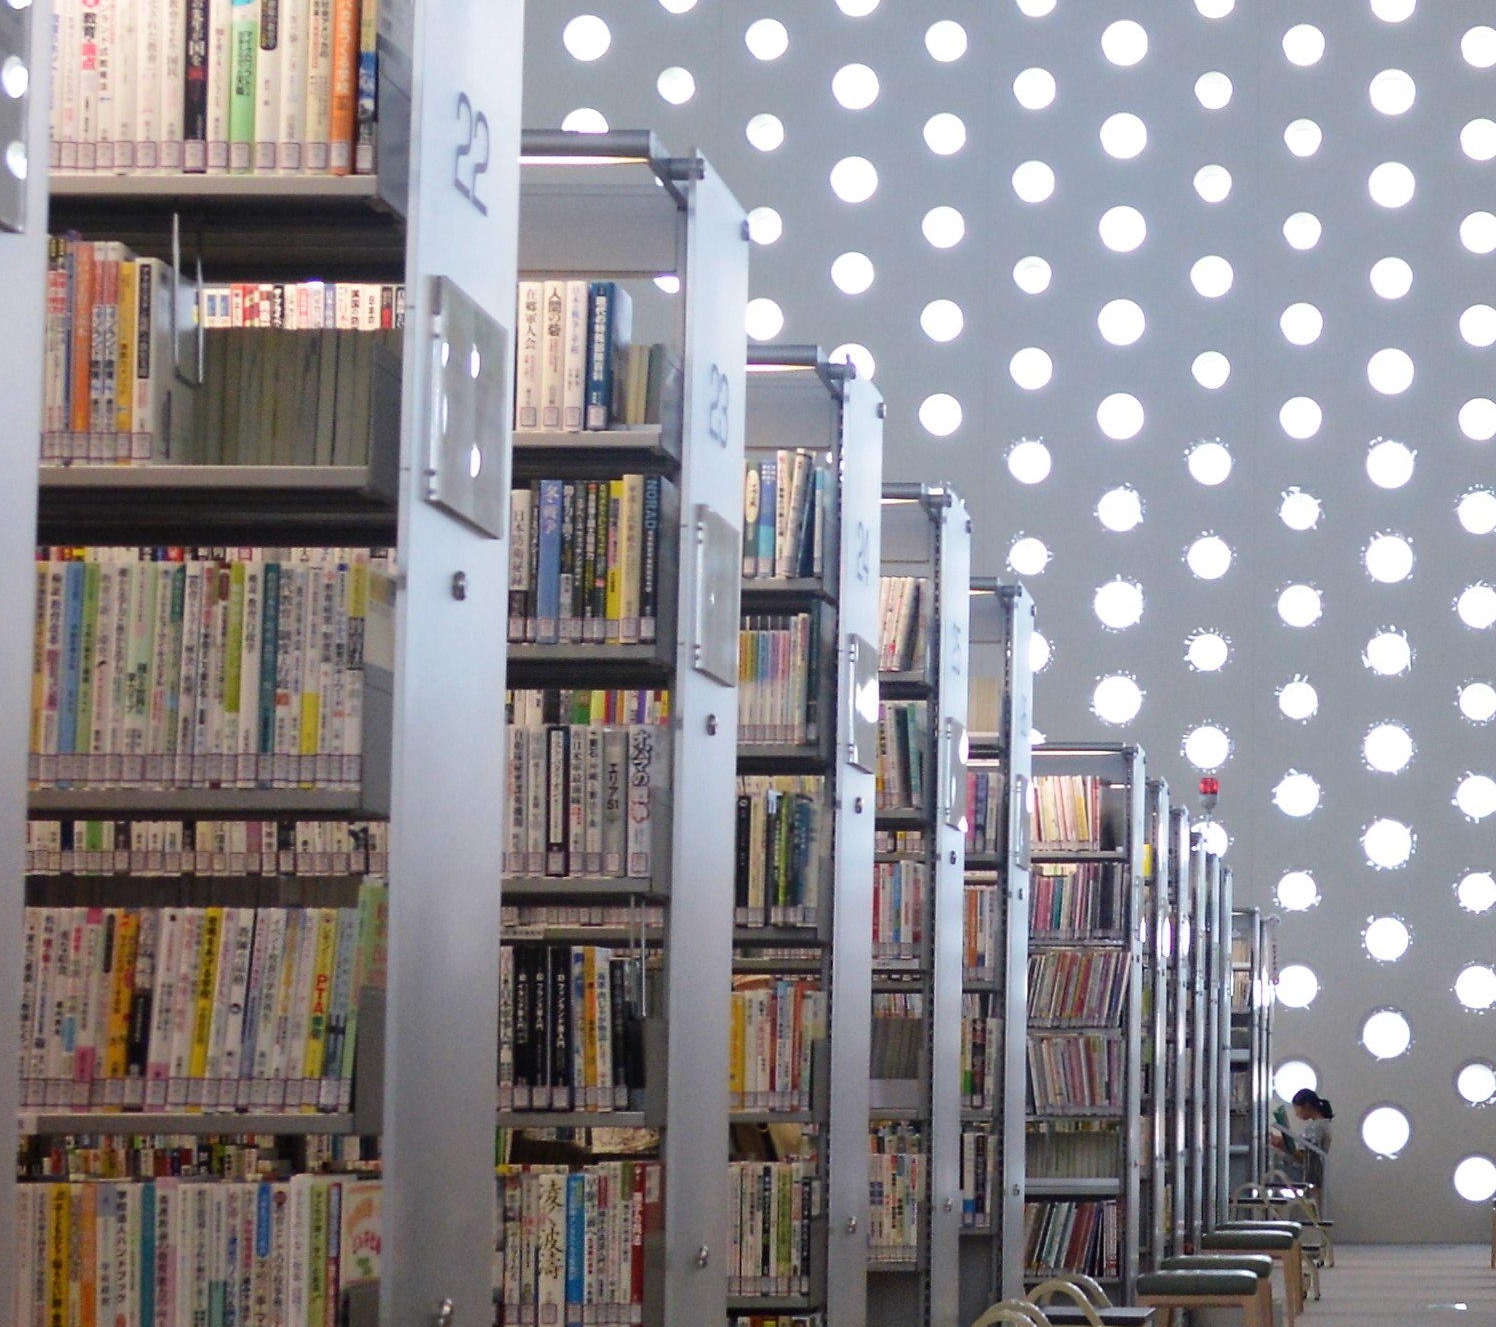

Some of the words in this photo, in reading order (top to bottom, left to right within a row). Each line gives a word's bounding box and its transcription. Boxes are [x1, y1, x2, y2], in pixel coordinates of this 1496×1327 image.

[452, 89, 491, 218] 22
[524, 287, 538, 350] 在郷軍人会
[706, 363, 729, 450] 23
[544, 484, 558, 536] 冬戦争
[645, 479, 657, 530] NORAD
[315, 973, 327, 1015] PTA
